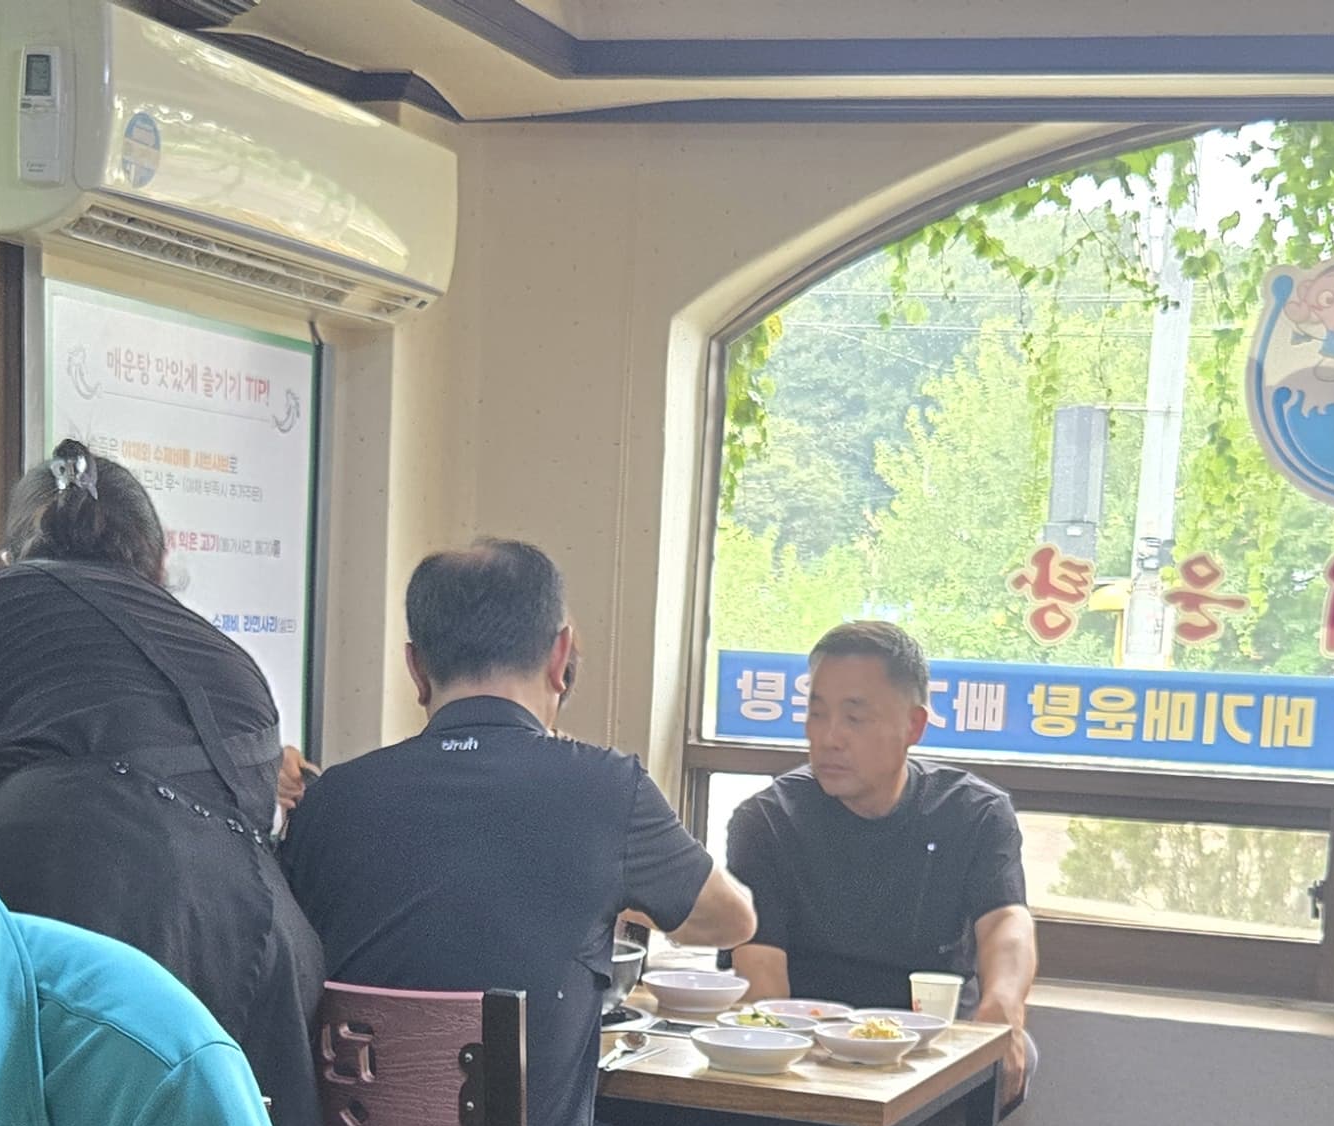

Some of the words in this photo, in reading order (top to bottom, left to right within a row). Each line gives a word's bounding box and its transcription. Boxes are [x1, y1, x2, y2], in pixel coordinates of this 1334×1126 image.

[106, 346, 151, 386] 매운탕
[155, 356, 198, 394] 맛있게
[201, 365, 242, 401] 즐기기
[245, 374, 272, 407] TIP!
